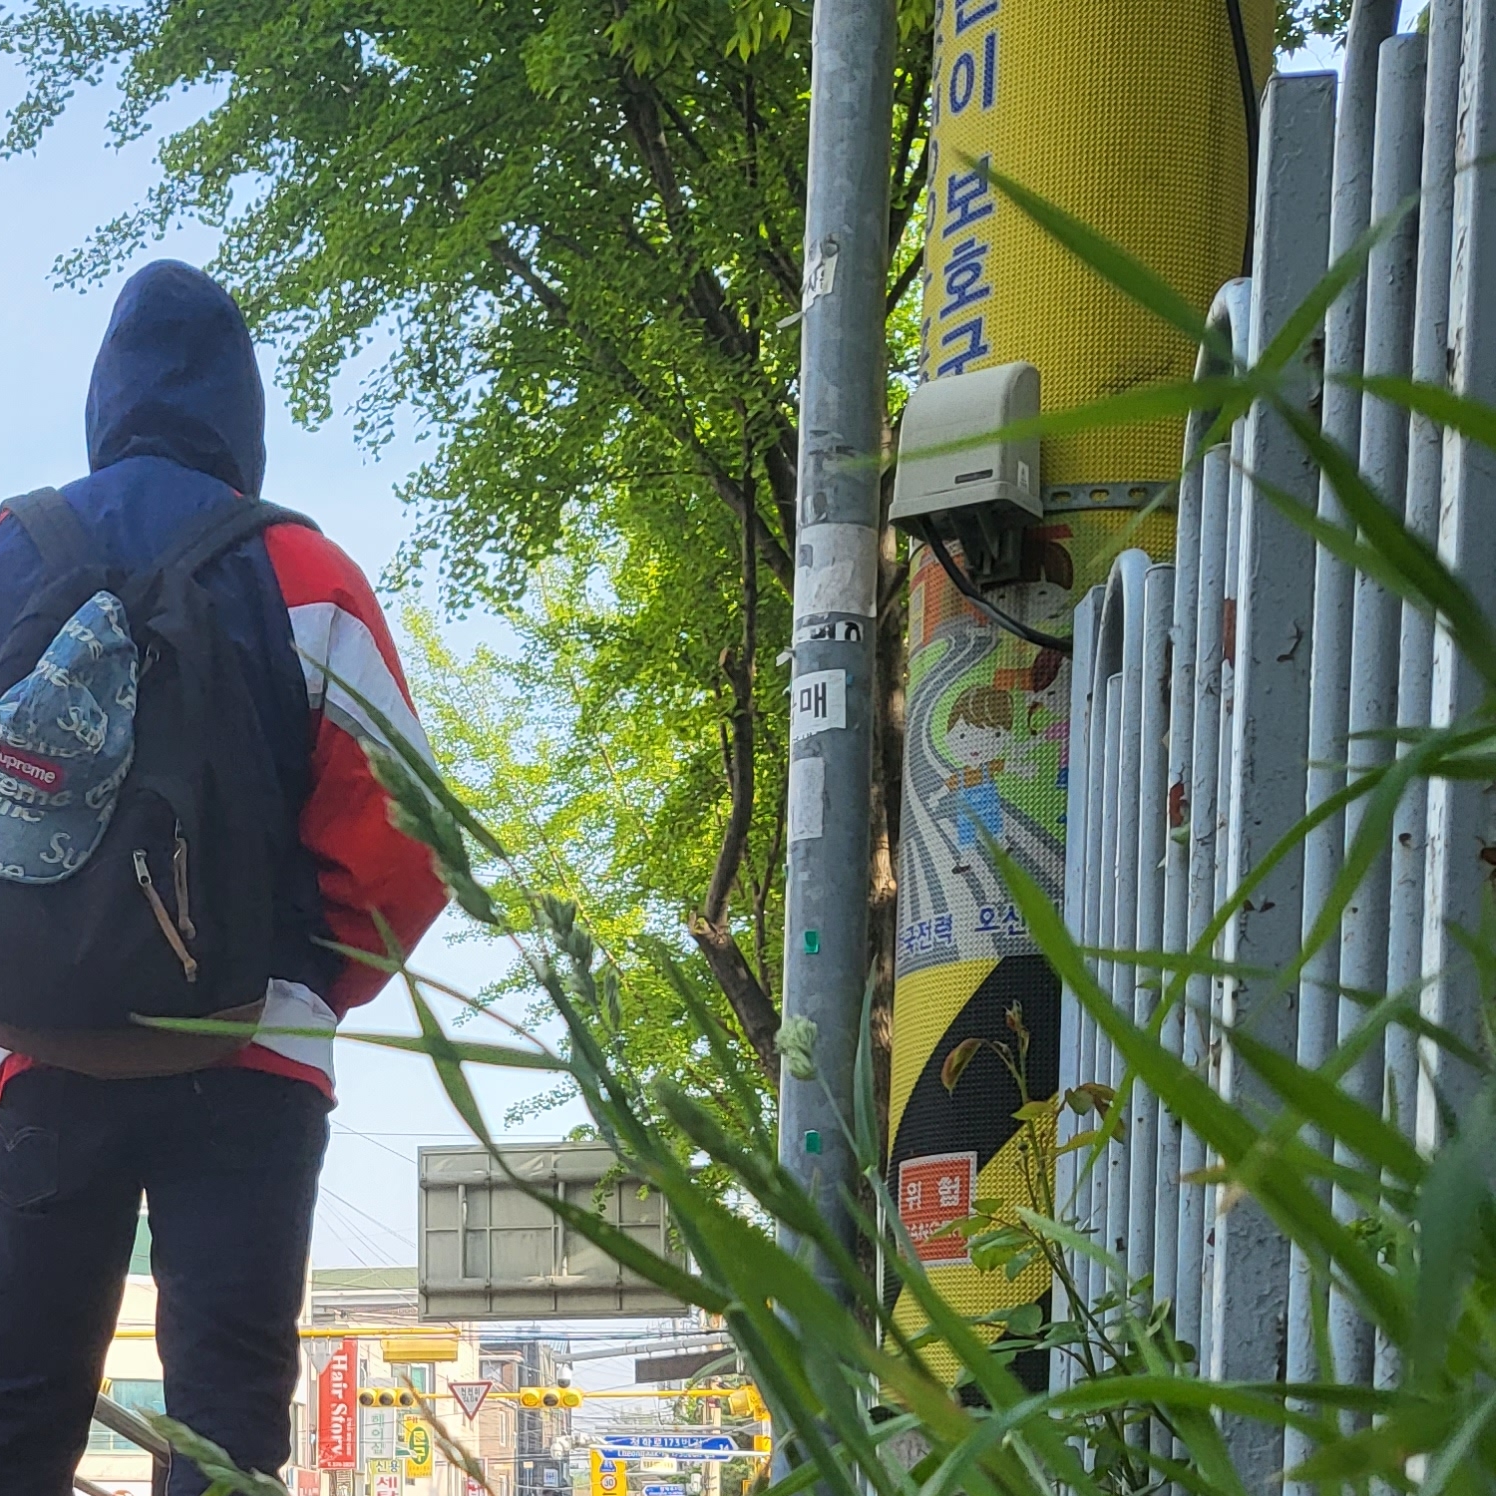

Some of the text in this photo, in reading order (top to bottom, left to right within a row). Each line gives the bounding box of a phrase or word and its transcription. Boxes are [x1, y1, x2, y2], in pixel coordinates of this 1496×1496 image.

[330, 1353, 348, 1400] Hair
[330, 1402, 347, 1456] Story
[375, 1461, 400, 1473] 신용
[604, 1477, 614, 1487] 30
